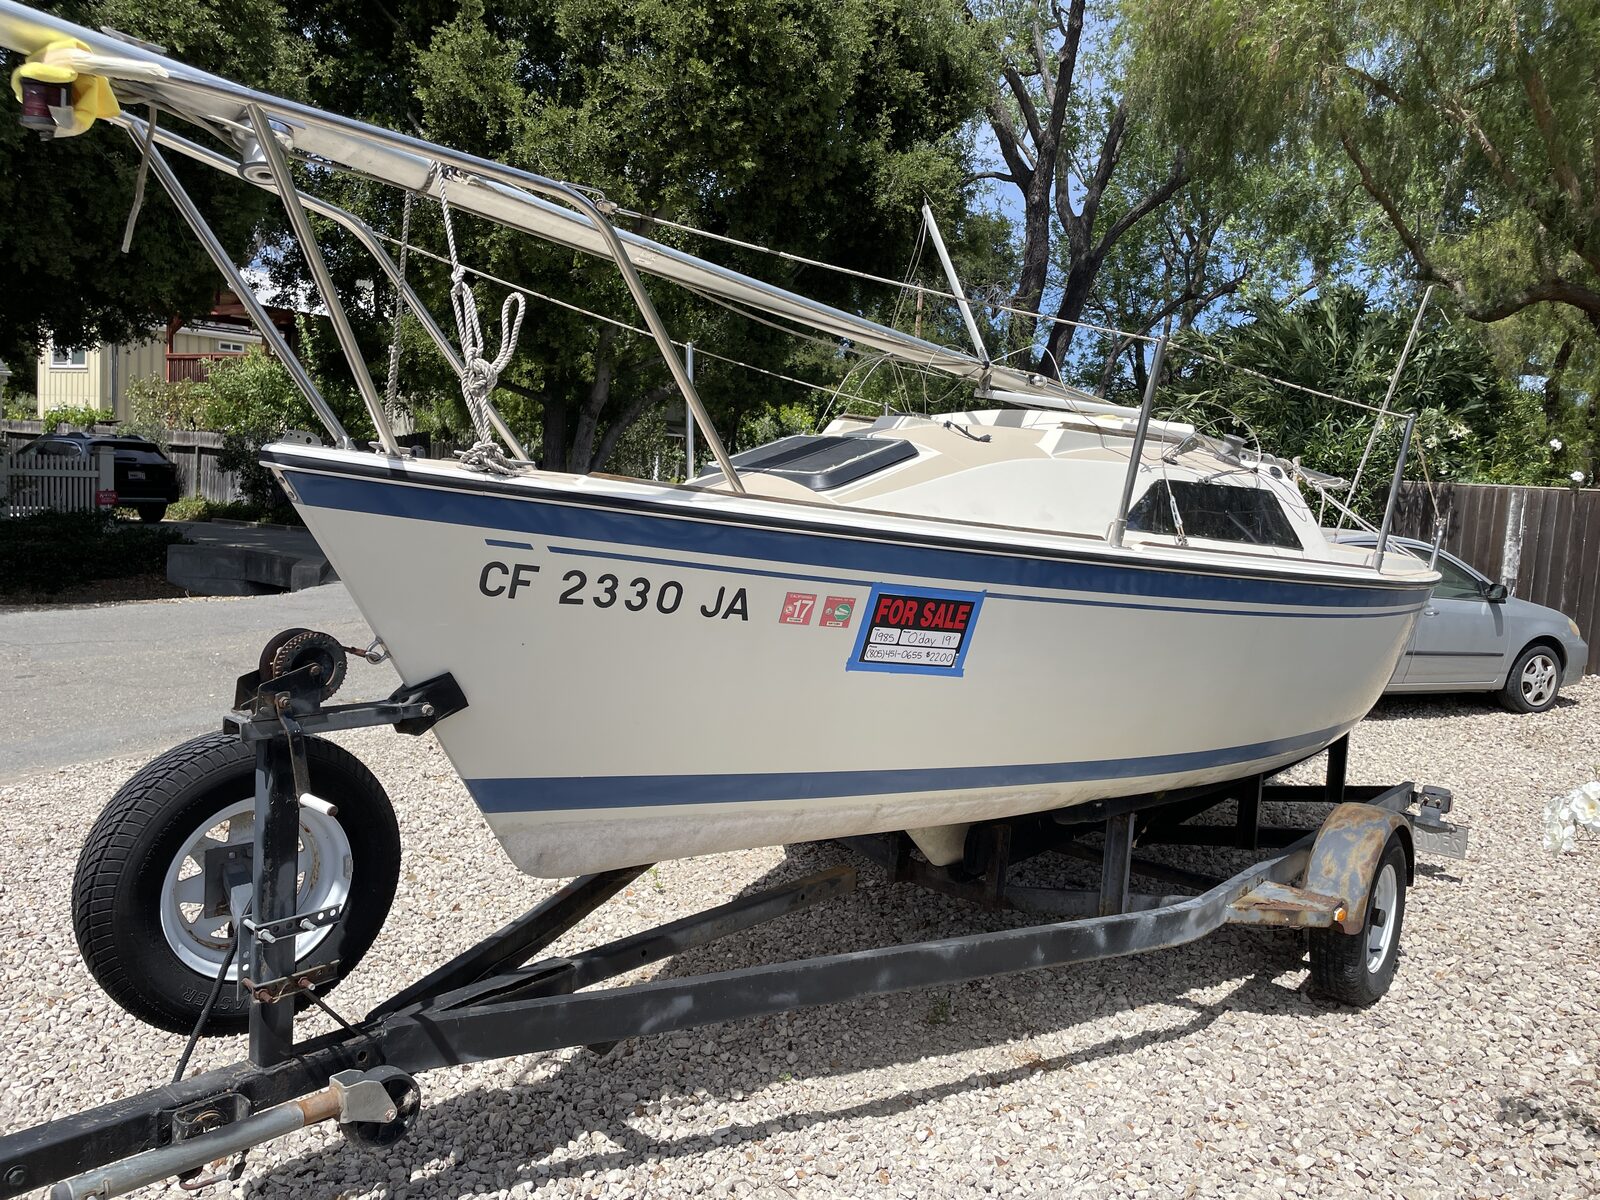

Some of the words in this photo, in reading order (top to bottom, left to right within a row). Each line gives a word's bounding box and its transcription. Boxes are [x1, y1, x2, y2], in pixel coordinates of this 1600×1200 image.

[479, 561, 541, 599] CF
[558, 569, 684, 614] 2330
[700, 586, 749, 621] JA
[793, 599, 814, 618] 17
[875, 598, 918, 626] FOR
[920, 602, 971, 629] SALE
[874, 631, 895, 642] 1985
[926, 652, 953, 662] $2200
